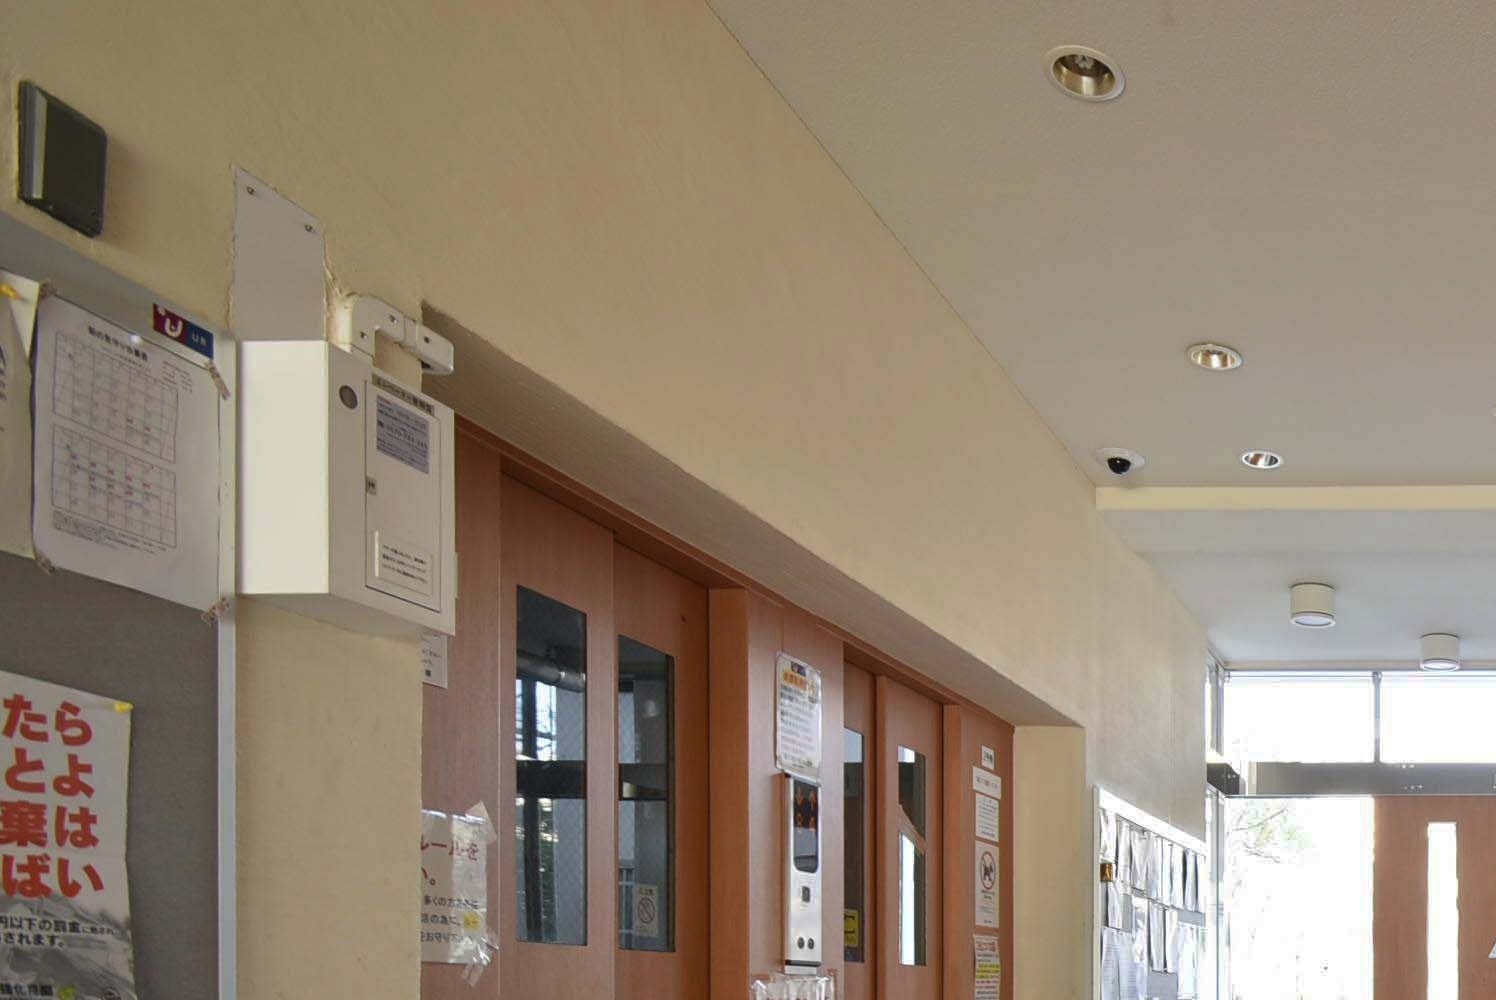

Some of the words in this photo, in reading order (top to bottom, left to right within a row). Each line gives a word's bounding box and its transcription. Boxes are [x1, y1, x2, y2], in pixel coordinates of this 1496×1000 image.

[3, 693, 93, 746] たら
[5, 748, 95, 798] とよ
[0, 800, 99, 848] 棄は
[2, 853, 104, 898] ばい
